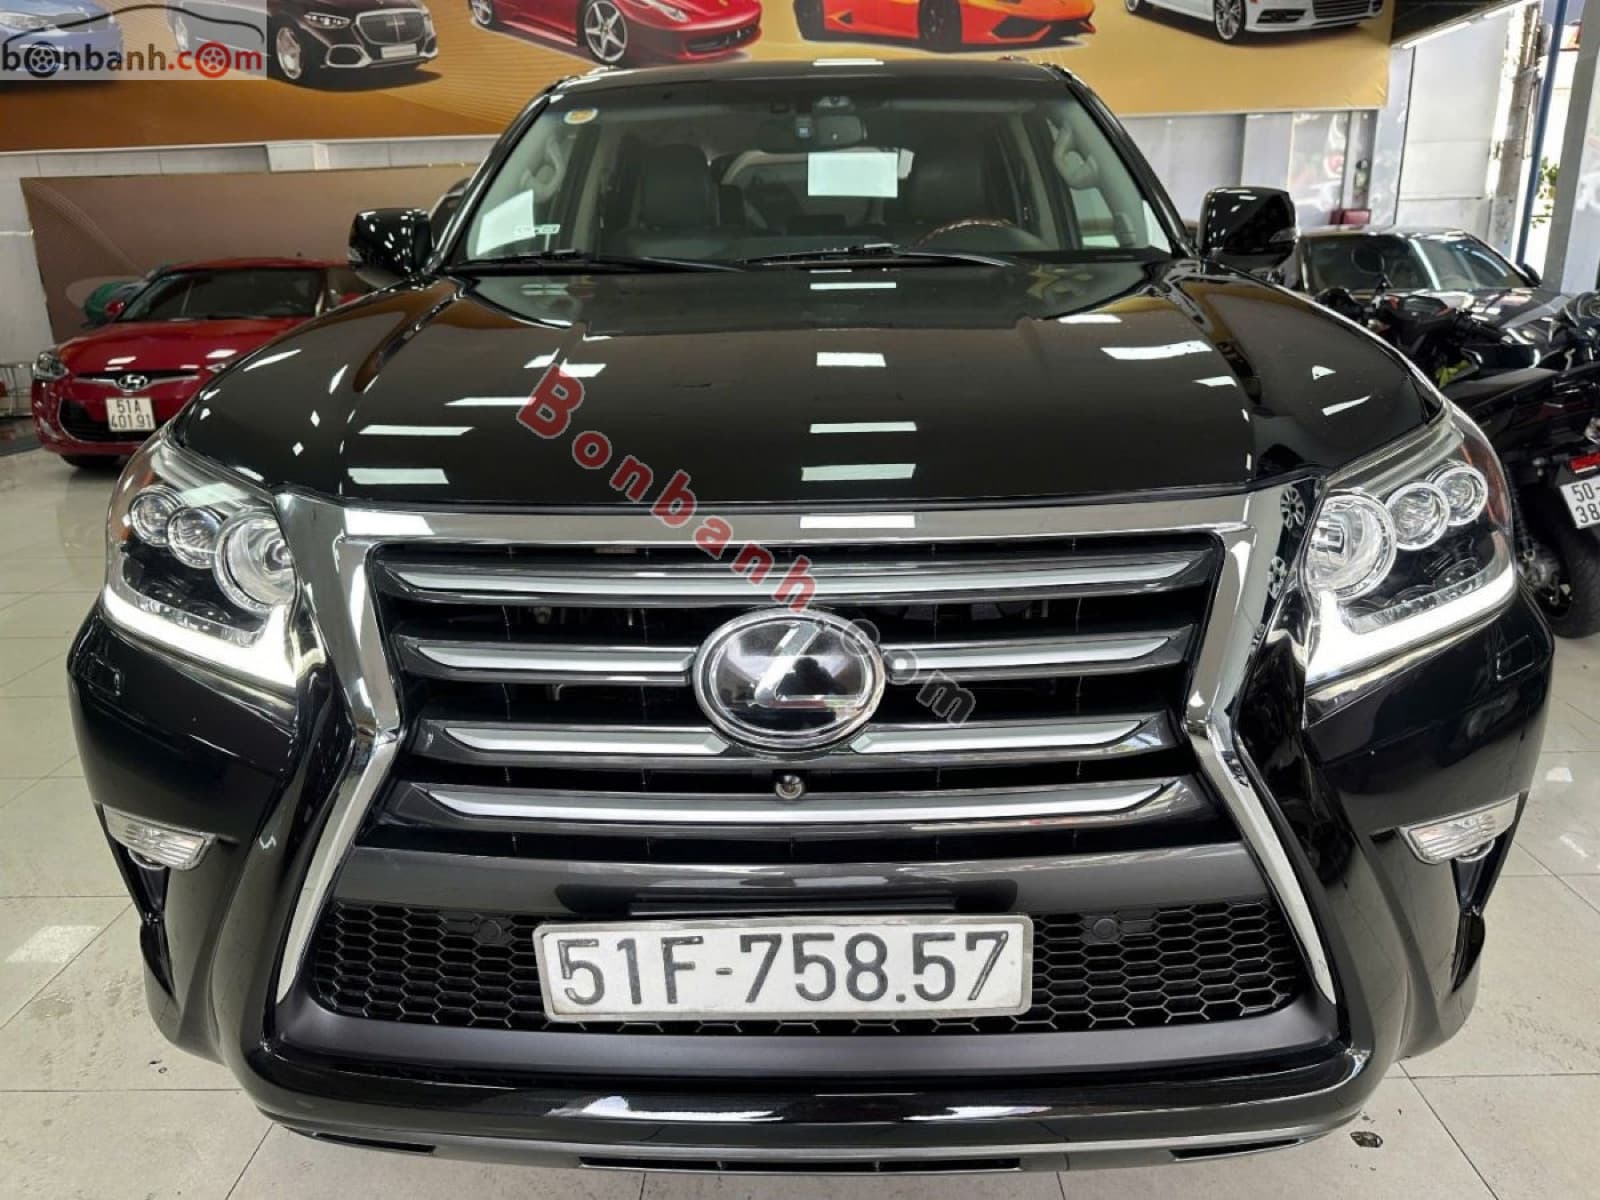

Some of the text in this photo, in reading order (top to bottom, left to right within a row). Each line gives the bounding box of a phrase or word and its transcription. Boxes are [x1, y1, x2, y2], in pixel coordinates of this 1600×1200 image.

[116, 399, 142, 414] 51A
[1575, 503, 1600, 524] 38
[556, 930, 1009, 1006] 51F-758.57
